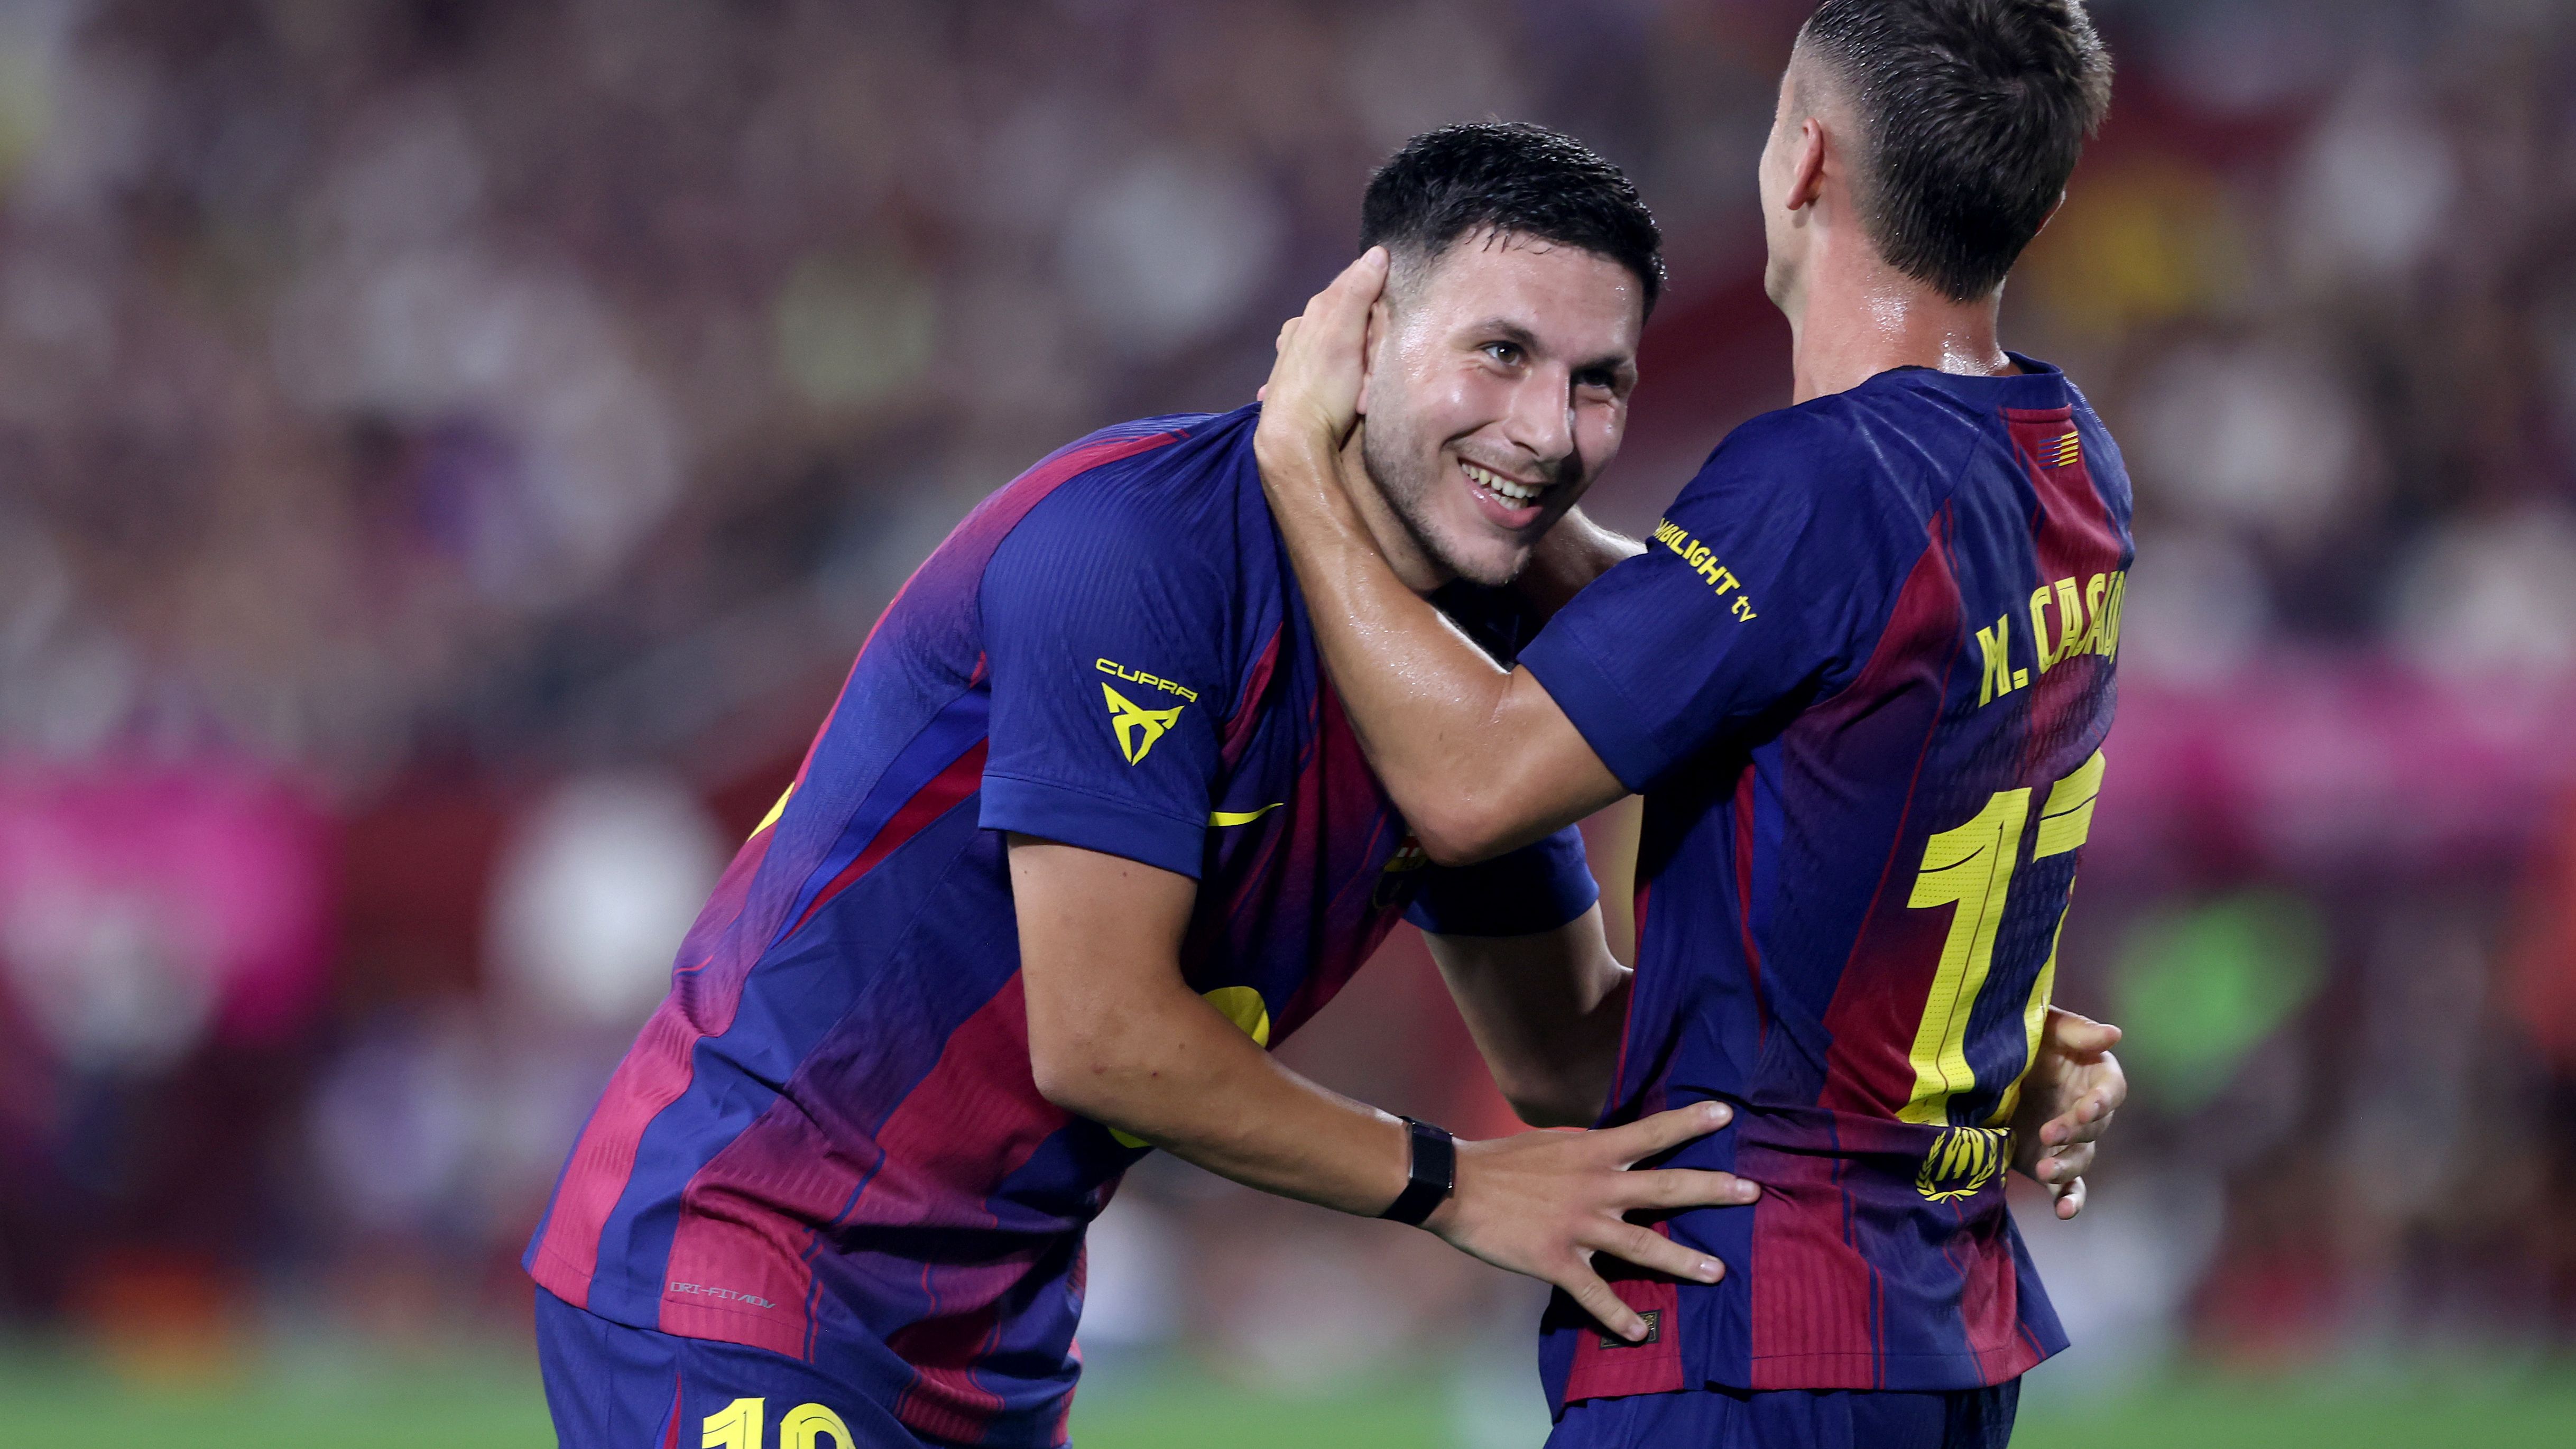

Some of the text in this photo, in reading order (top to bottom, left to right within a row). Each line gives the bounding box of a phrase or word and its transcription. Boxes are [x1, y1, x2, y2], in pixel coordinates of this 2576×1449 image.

[1652, 517, 1758, 623] MBILIGHT tv
[1095, 658, 1198, 703] CUPRA
[1975, 613, 2029, 708] M.
[1895, 747, 2106, 1128] 17
